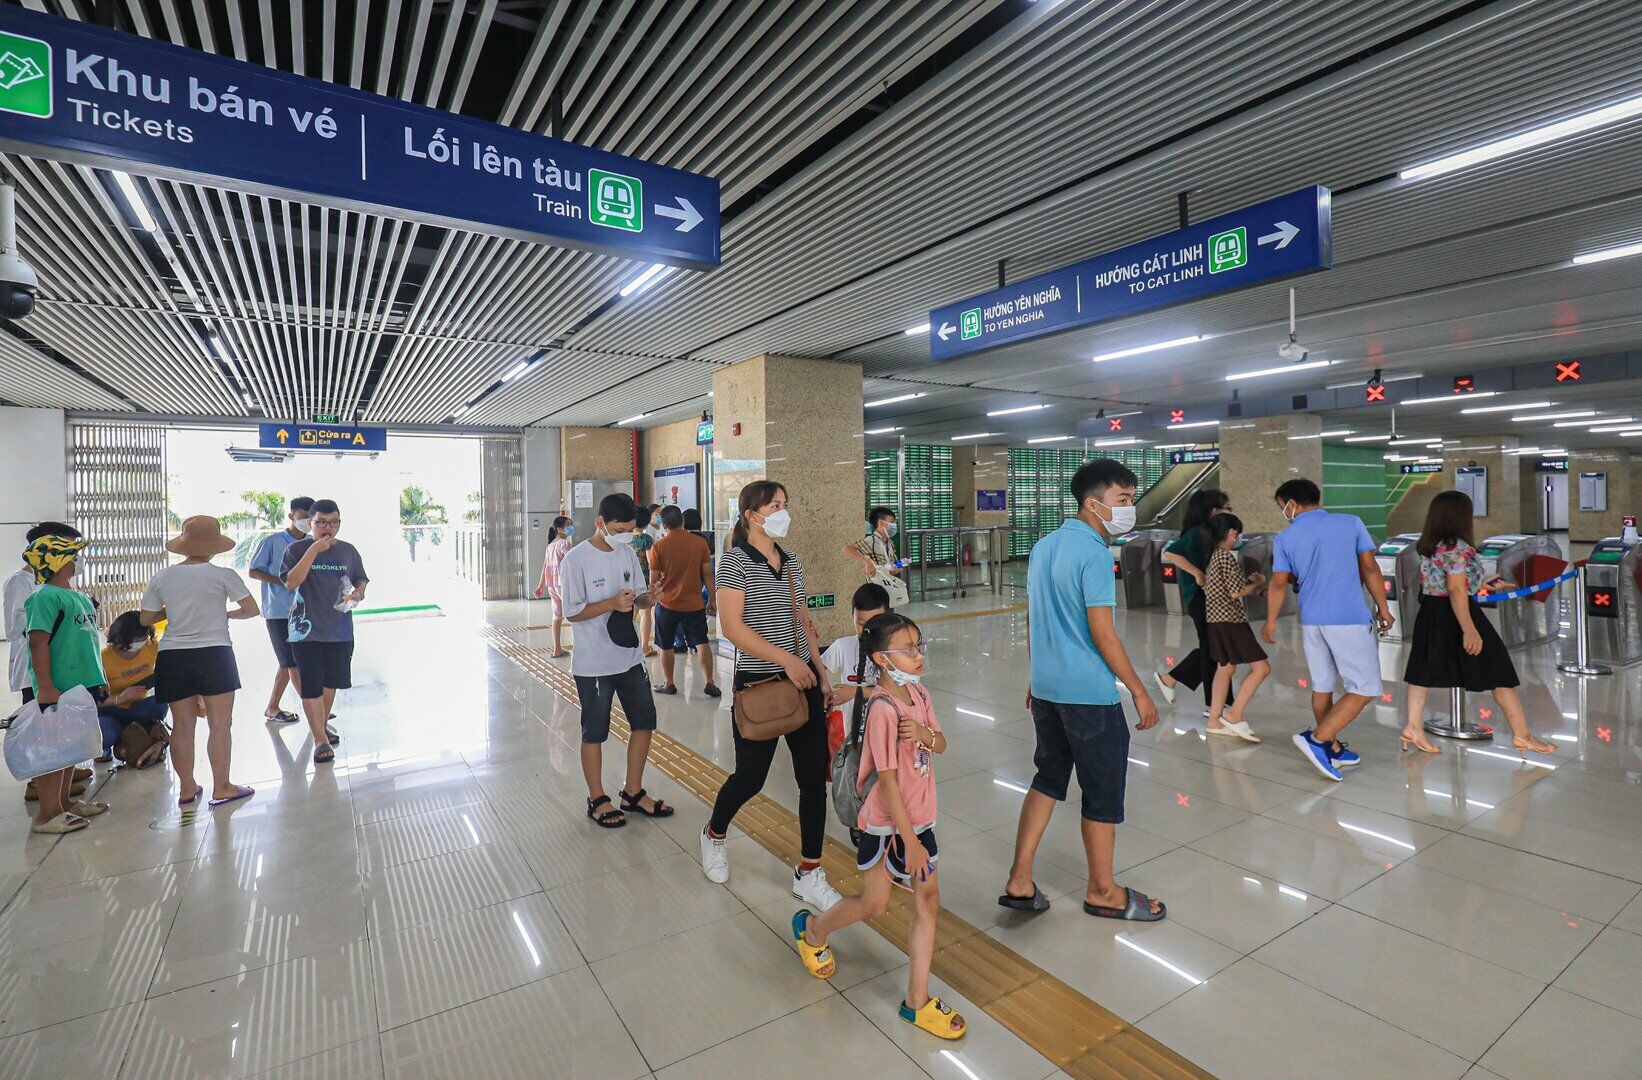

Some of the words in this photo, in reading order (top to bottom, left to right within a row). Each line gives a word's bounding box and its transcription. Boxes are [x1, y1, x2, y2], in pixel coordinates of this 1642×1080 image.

[66, 48, 170, 104] Khu
[189, 76, 273, 126] bán
[288, 107, 338, 139] vé
[67, 97, 194, 144] Tickets
[404, 126, 460, 166] Lối
[473, 141, 522, 179] lên
[532, 157, 582, 192] tàu
[532, 192, 582, 219] Train
[1095, 264, 1140, 289] HƯỚNG
[1143, 252, 1169, 275] CÁT
[1172, 243, 1203, 267] LINH
[1129, 281, 1145, 294] TO
[1147, 273, 1171, 290] CAT
[1173, 264, 1204, 283] LINH
[1014, 294, 1032, 312] YÊN
[1033, 285, 1062, 307] NGHĨA
[984, 322, 996, 333] TO
[996, 317, 1014, 330] YEN
[1015, 309, 1045, 325] NGHIA
